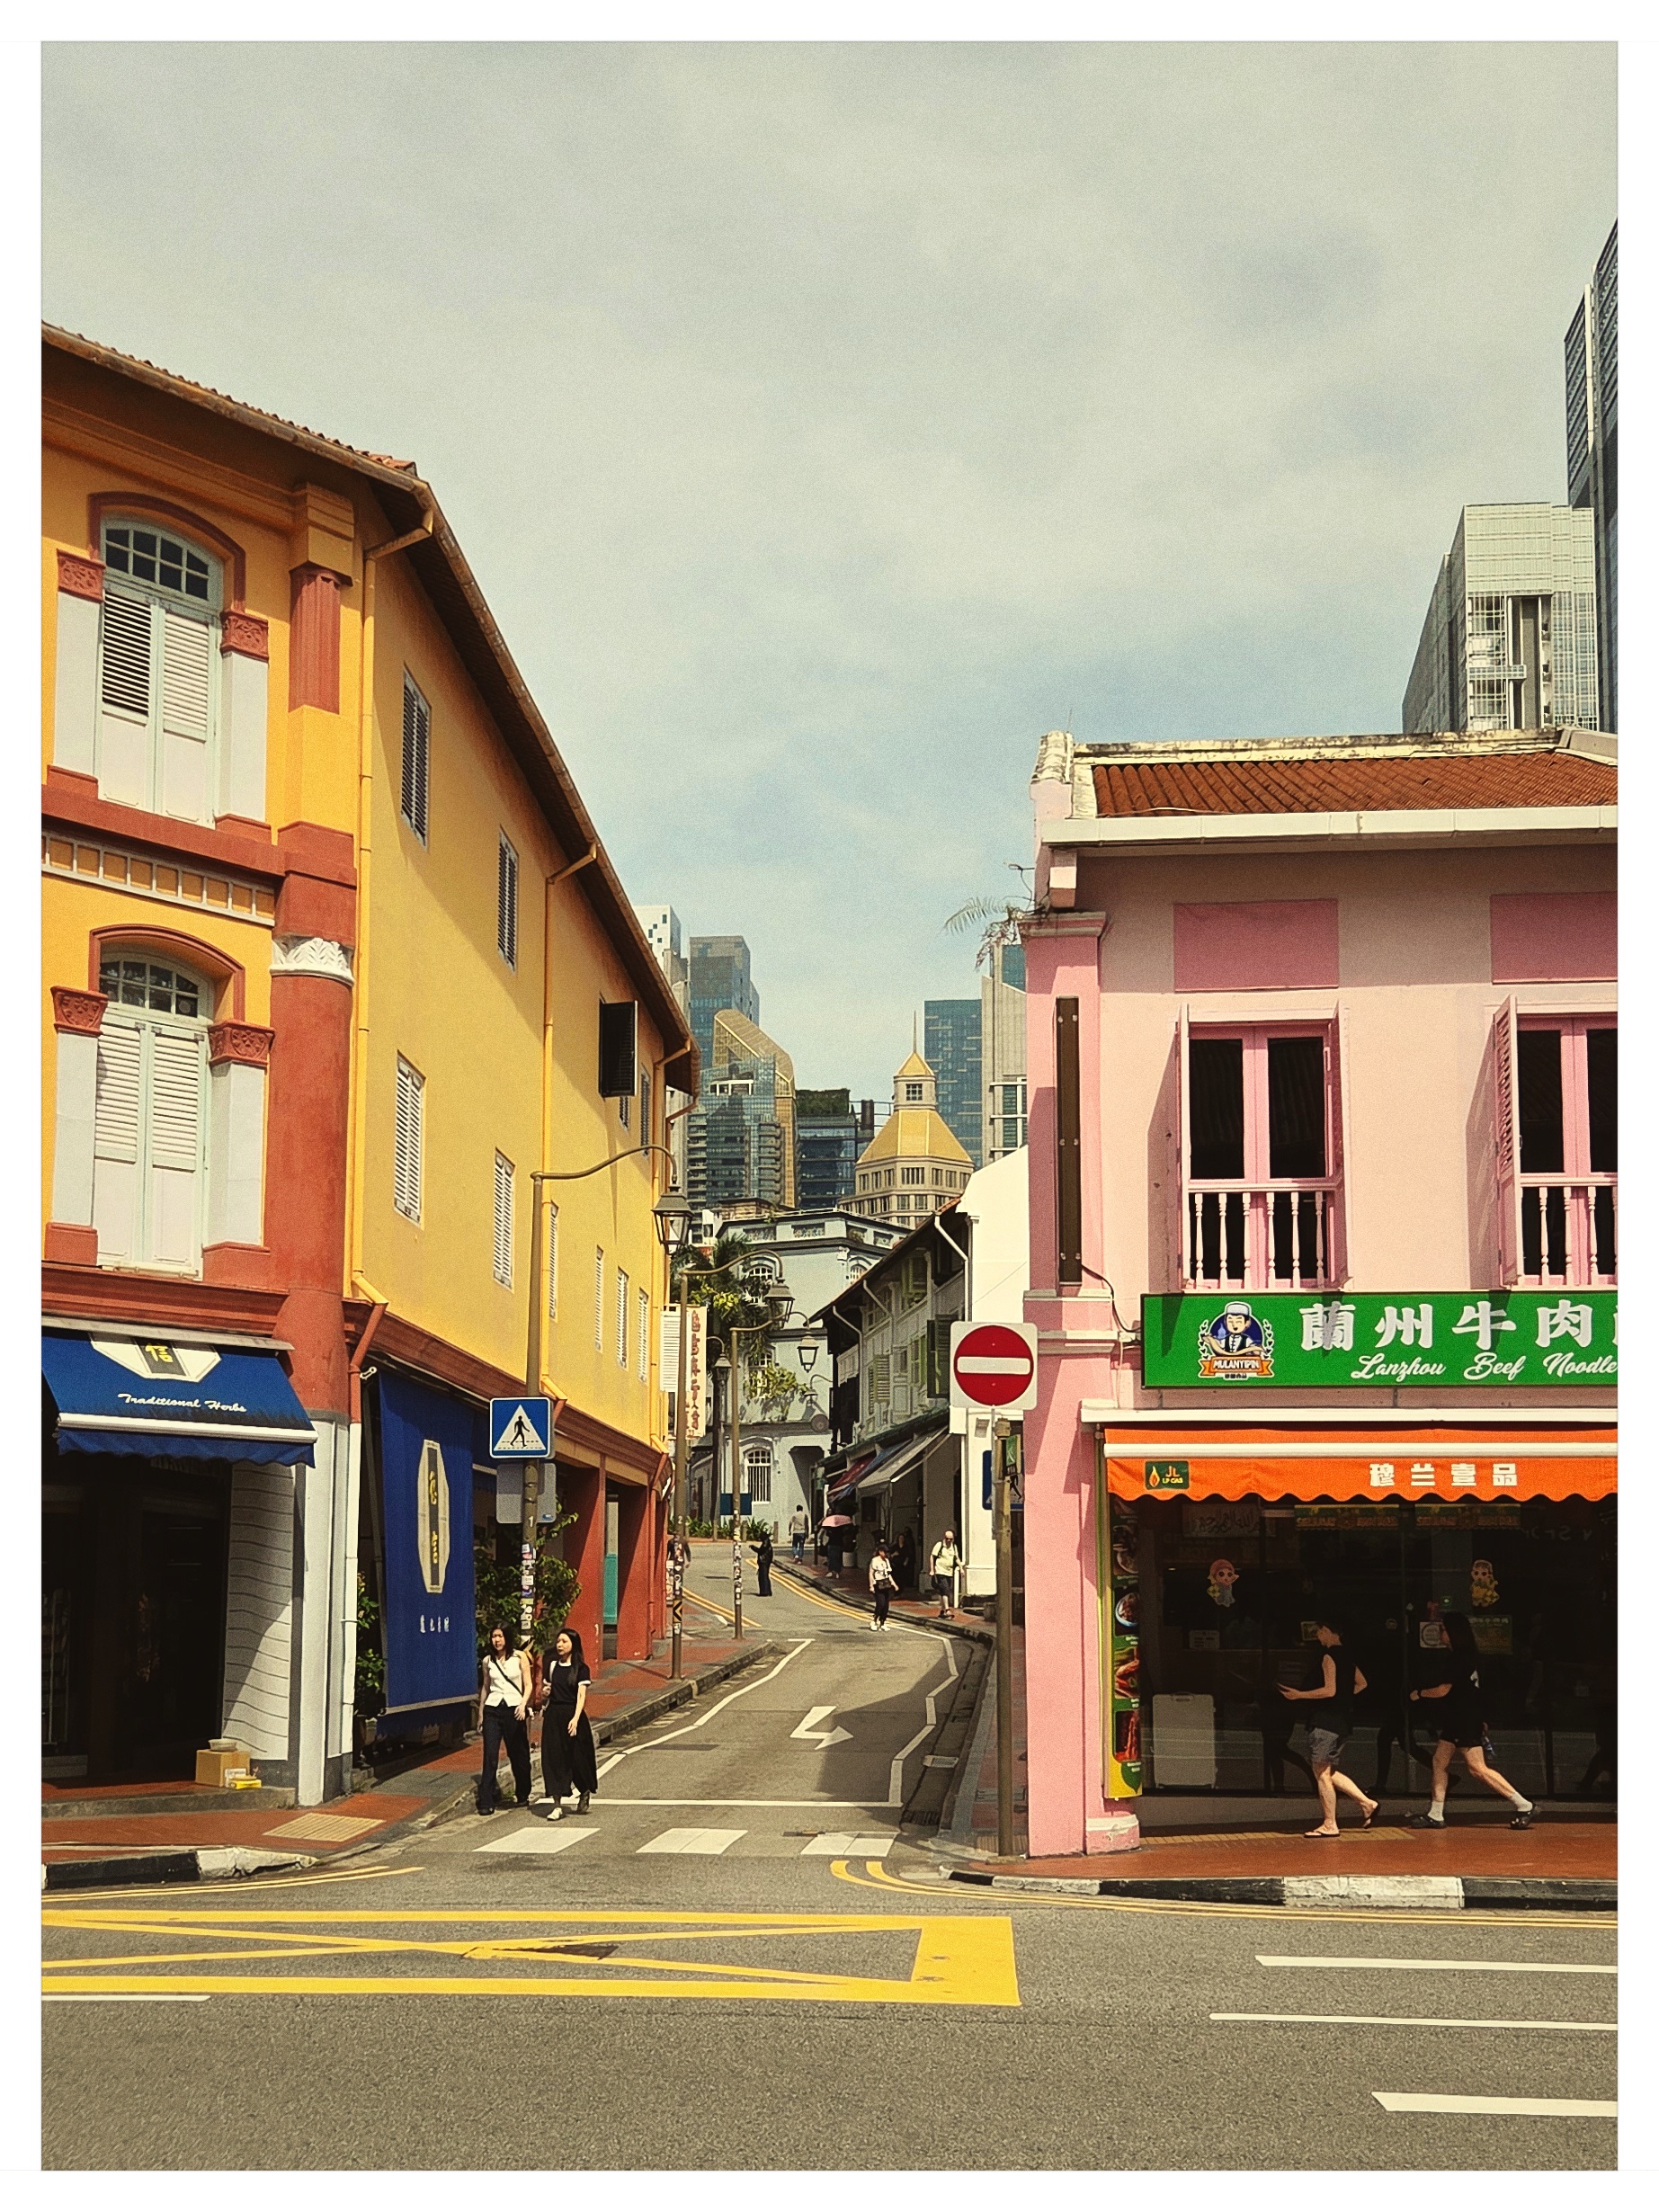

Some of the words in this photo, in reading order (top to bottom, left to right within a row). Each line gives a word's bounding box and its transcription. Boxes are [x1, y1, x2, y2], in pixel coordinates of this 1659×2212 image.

[1298, 1298, 1618, 1351] 蘭州牛肉
[1212, 1360, 1261, 1369] MULANYIPIN
[1350, 1352, 1446, 1382] Lanzhou
[1463, 1351, 1527, 1380] Beef
[118, 1393, 201, 1408] Traditional
[204, 1400, 247, 1413] Herbs
[1165, 1465, 1181, 1477] JL
[1369, 1462, 1519, 1486] 穆兰壹品
